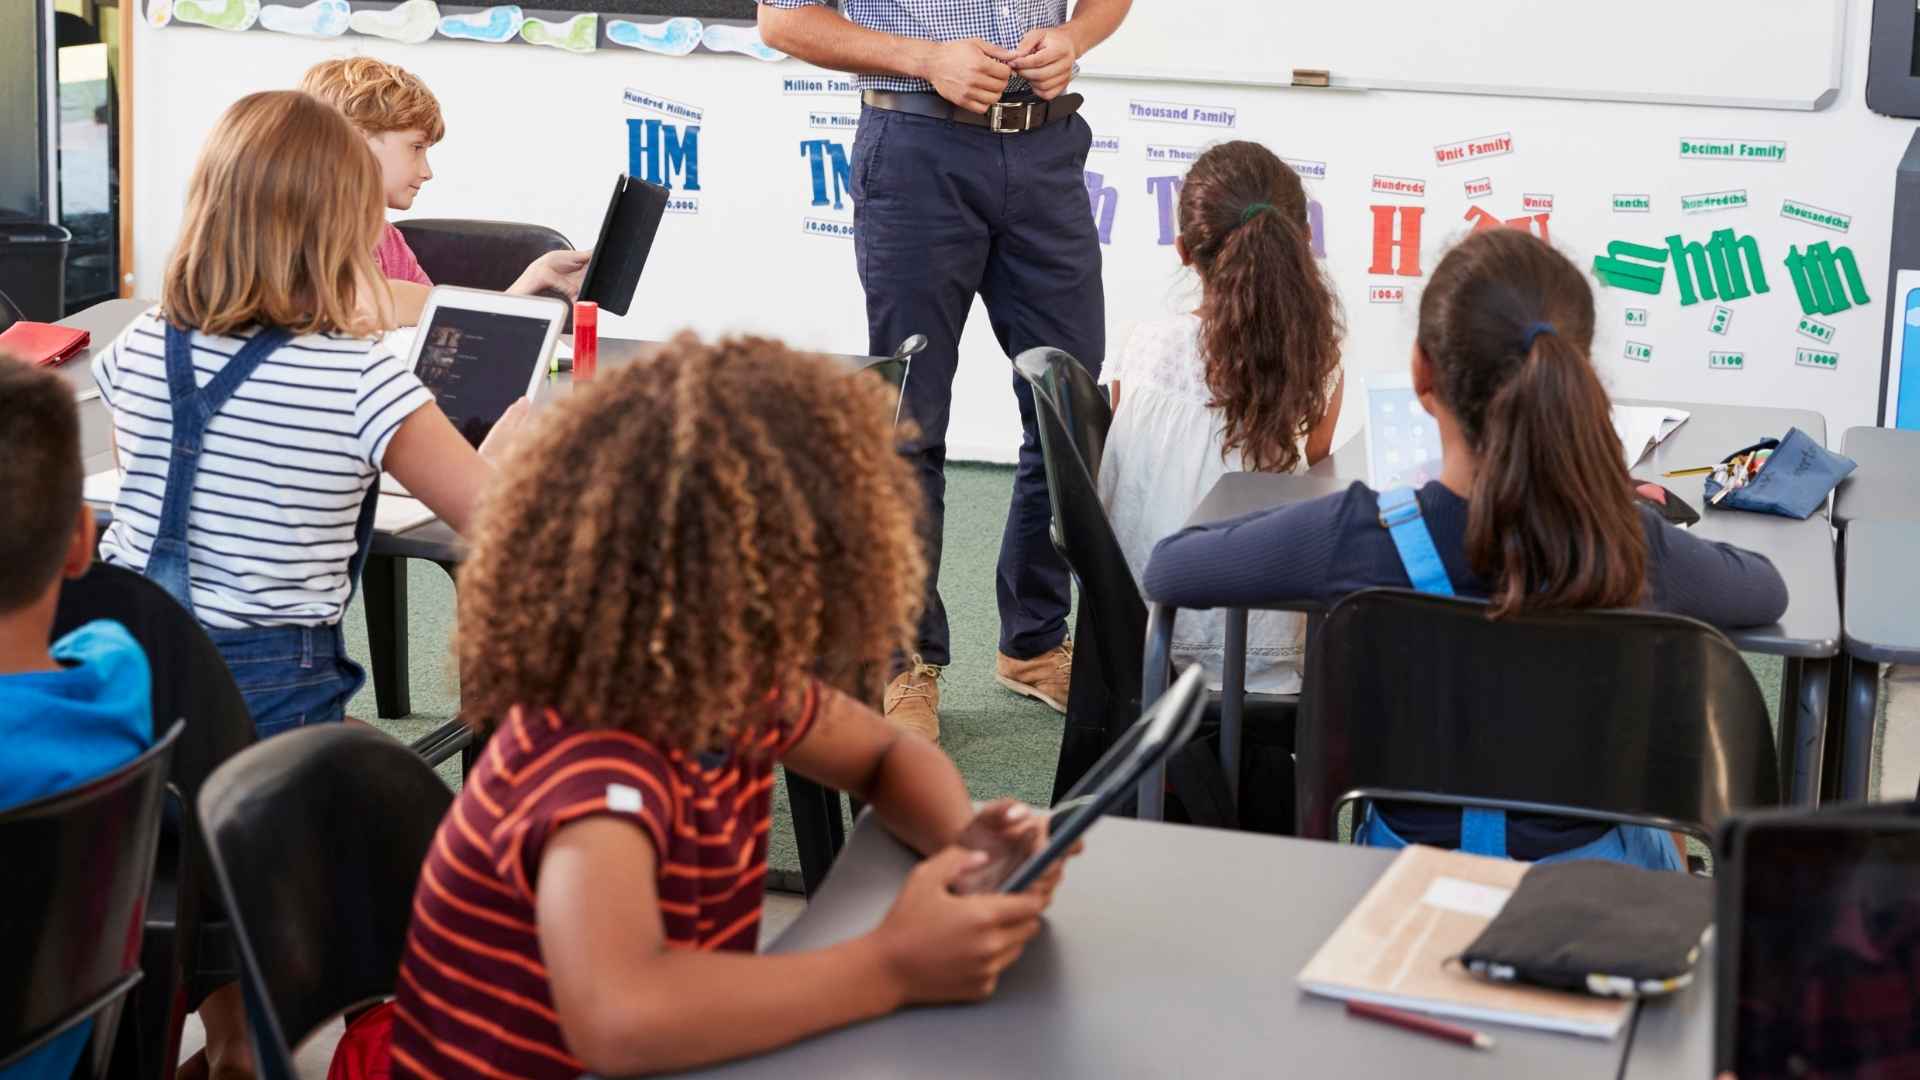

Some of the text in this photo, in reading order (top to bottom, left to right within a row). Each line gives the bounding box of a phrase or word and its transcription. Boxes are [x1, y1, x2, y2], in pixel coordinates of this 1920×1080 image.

[784, 79, 823, 92] Million
[623, 91, 702, 120] Hundred Millions
[809, 115, 828, 125] Ten
[1129, 103, 1236, 126] Thousand Family
[625, 118, 701, 191] HM
[1146, 147, 1165, 158] Ten
[1435, 137, 1511, 163] Unit Family
[1680, 142, 1785, 160] Decimal Family
[1372, 178, 1425, 193] Hundreds
[1465, 182, 1492, 194] Tens
[1523, 197, 1553, 208] Units
[1614, 199, 1649, 208] tenths
[1682, 193, 1747, 210] hundredths
[1783, 204, 1849, 229] thousandths
[1368, 205, 1425, 277] H
